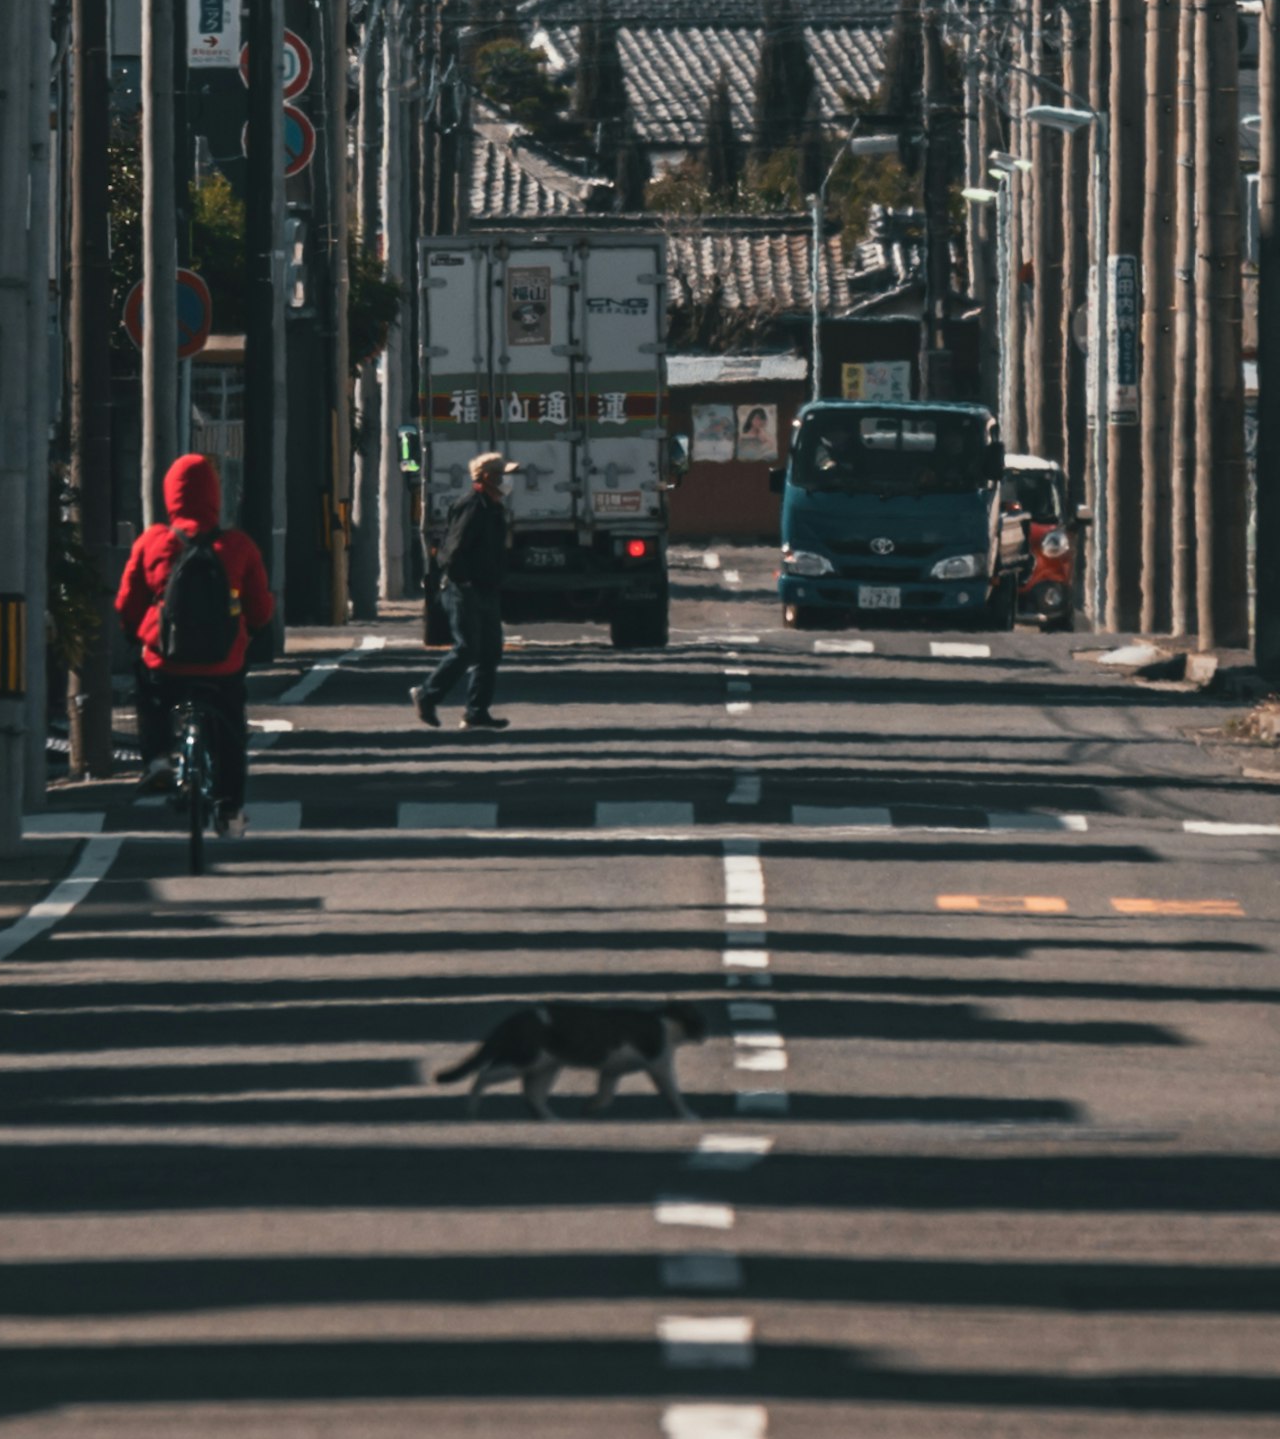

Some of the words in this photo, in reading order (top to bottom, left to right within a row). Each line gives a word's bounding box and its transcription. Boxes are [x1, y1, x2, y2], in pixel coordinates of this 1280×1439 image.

[585, 297, 649, 309] CNG
[449, 389, 629, 425] 福山通運
